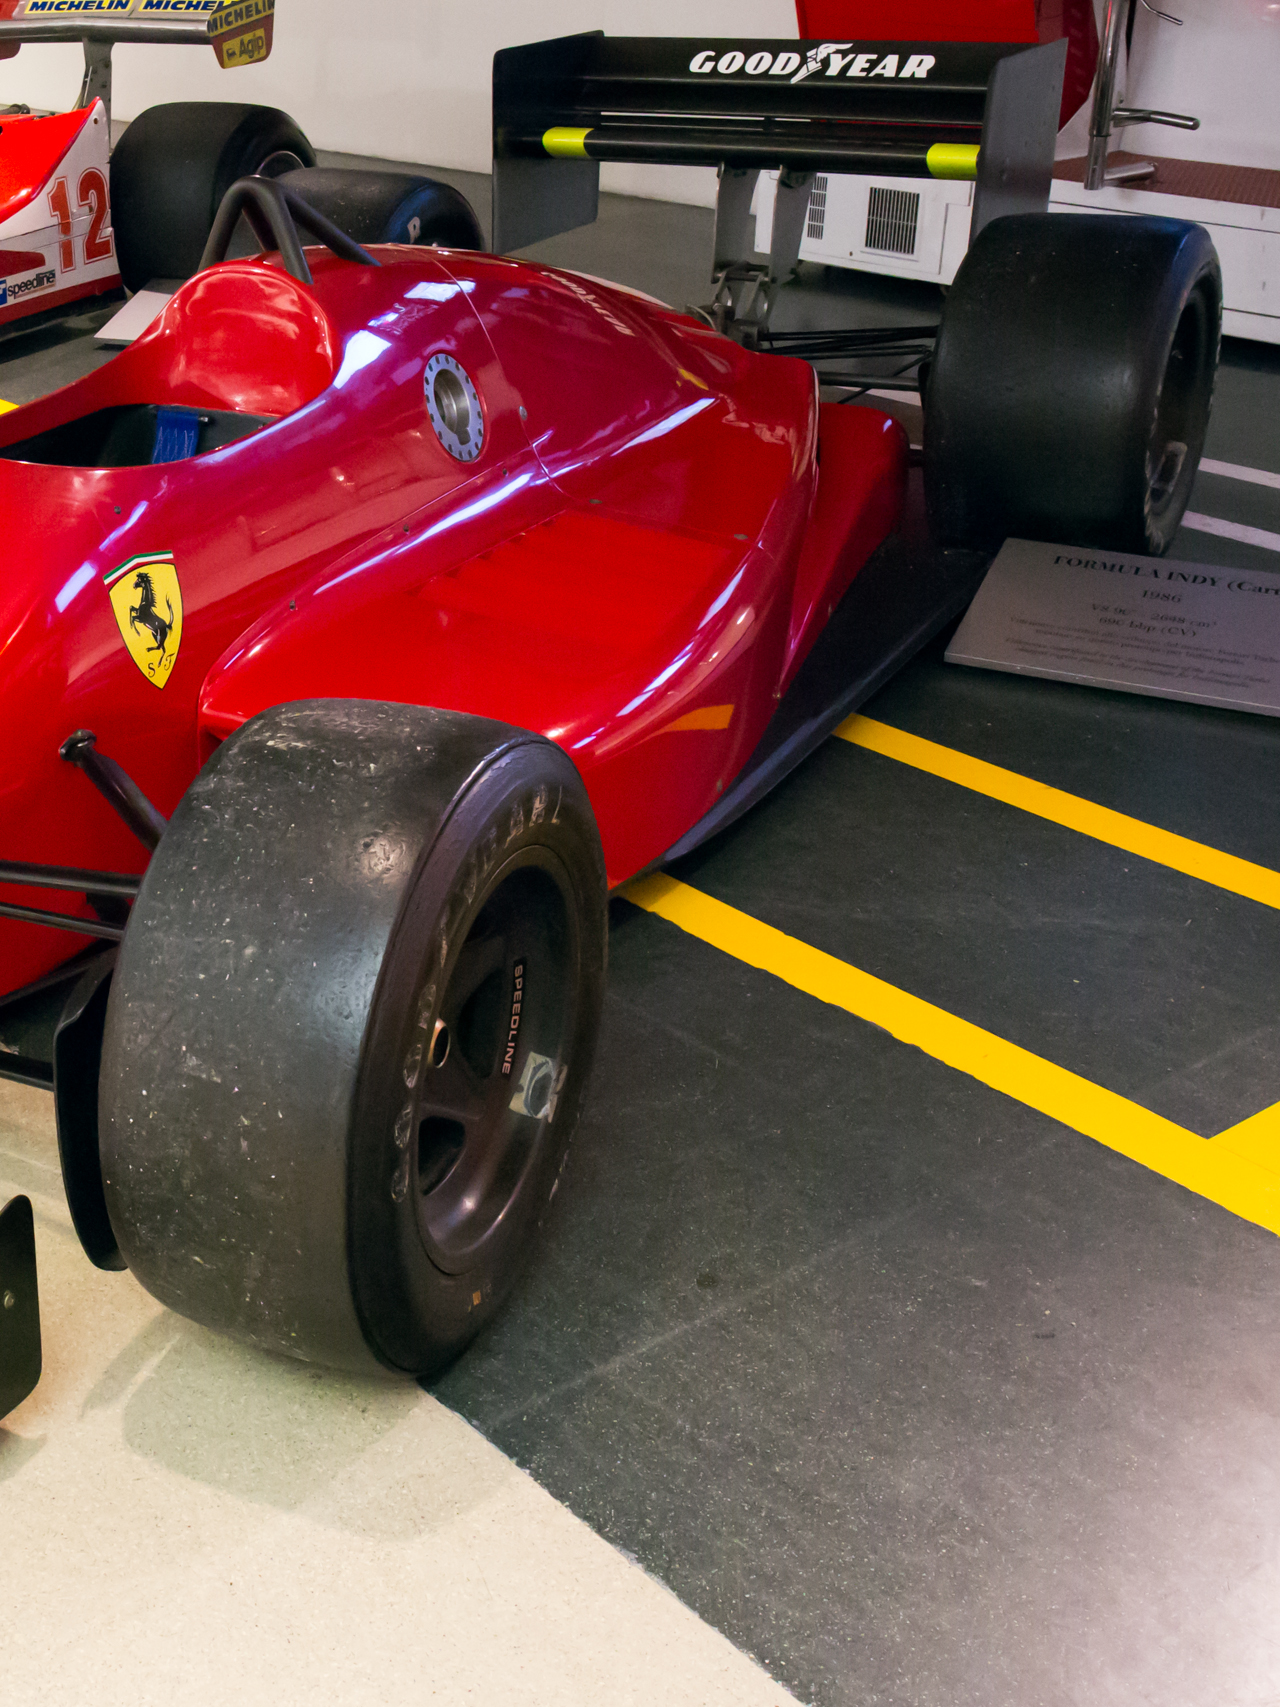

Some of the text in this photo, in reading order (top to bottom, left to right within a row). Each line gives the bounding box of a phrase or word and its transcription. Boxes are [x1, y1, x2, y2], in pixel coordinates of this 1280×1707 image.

[28, 0, 131, 11] MICHELIN
[142, 0, 223, 10] MICHE
[238, 33, 264, 59] Agip
[47, 166, 116, 275] 12
[7, 269, 56, 299] speedline
[1053, 555, 1161, 579] FORMULA
[1166, 570, 1222, 587] INDY
[1141, 589, 1182, 604] 1986
[501, 964, 524, 1075] SPEEDLINE
